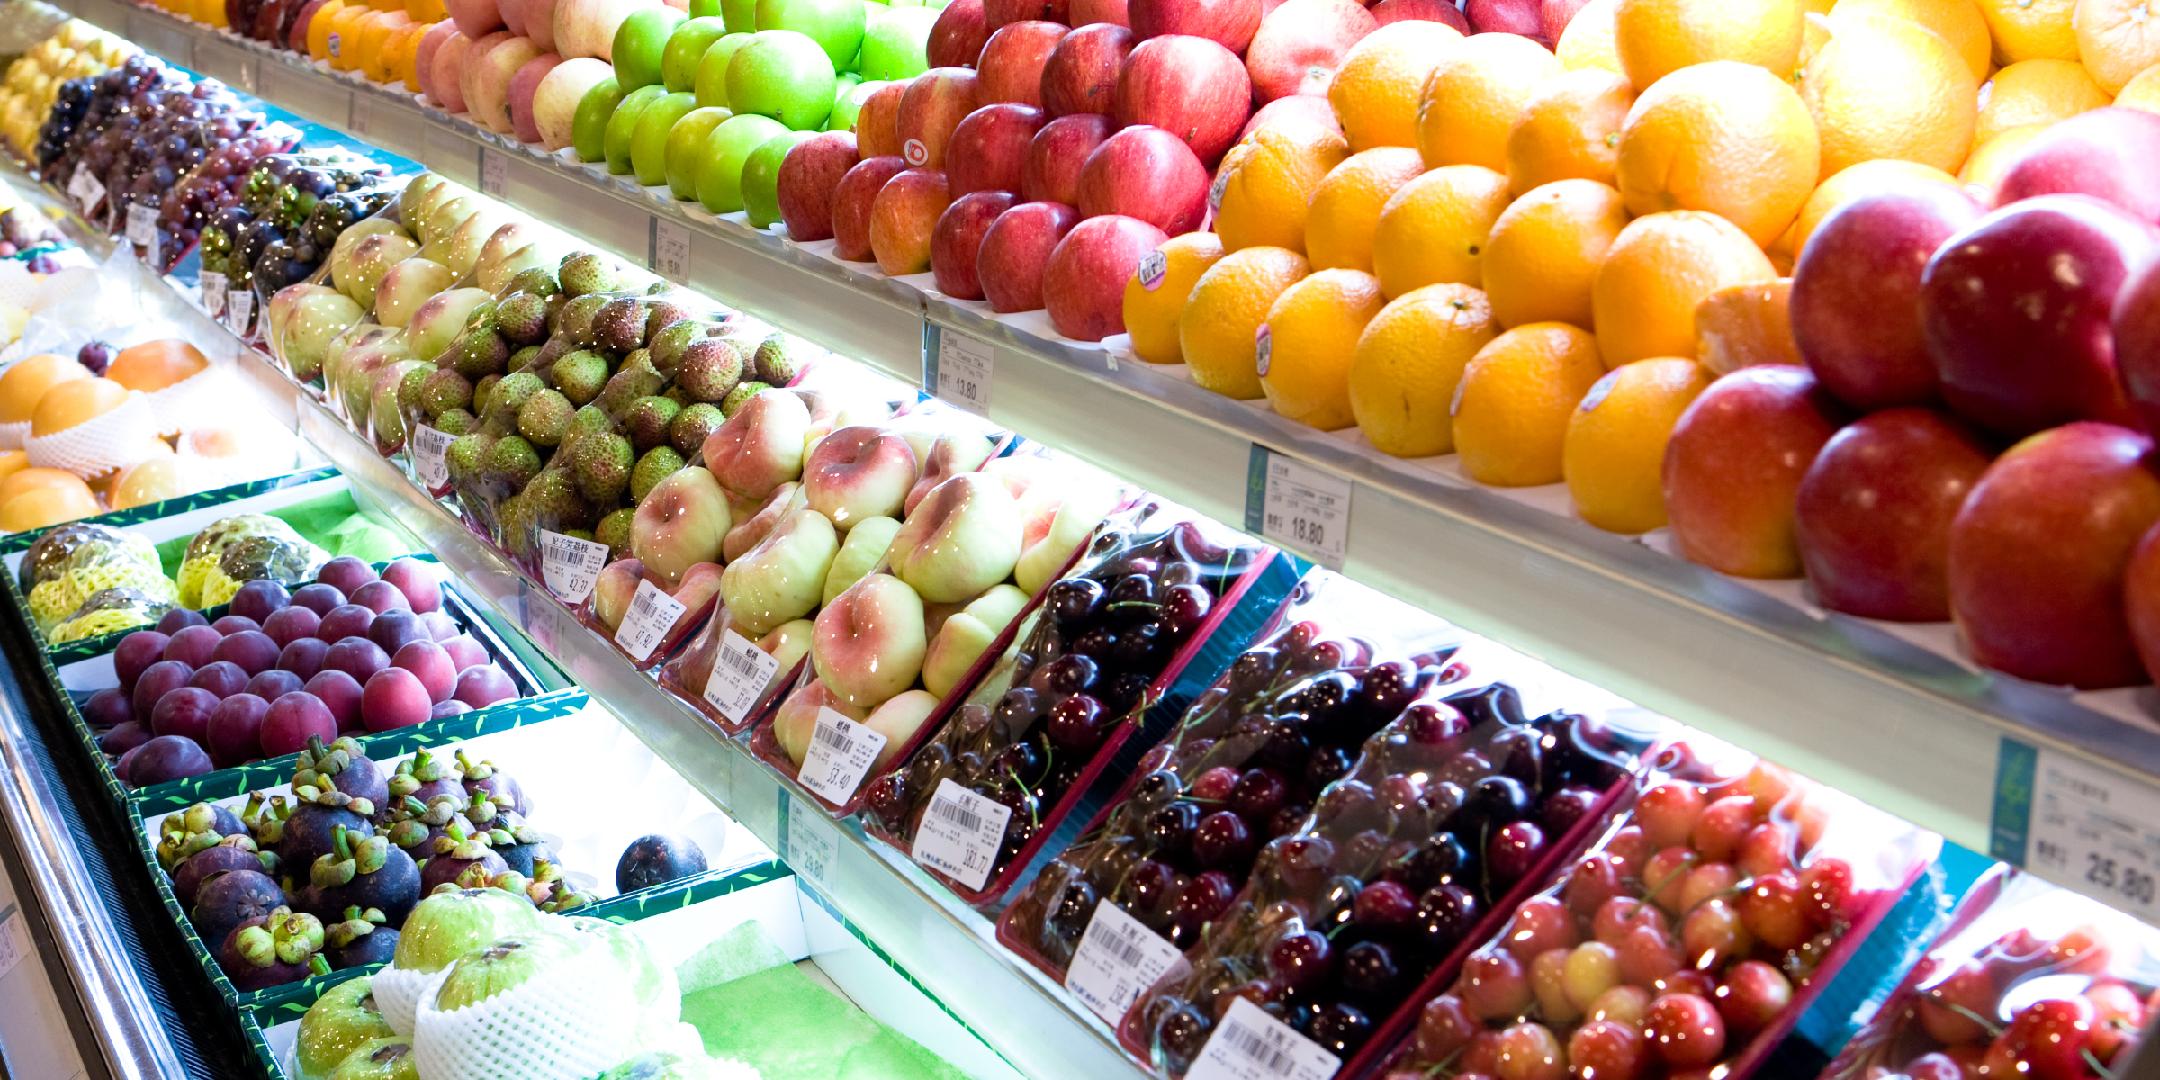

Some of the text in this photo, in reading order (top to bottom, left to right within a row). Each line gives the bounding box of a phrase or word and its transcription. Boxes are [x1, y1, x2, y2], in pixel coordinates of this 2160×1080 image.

[957, 377, 976, 400] 13.80
[1292, 516, 1324, 545] 18.80
[2086, 852, 2155, 904] 25.80
